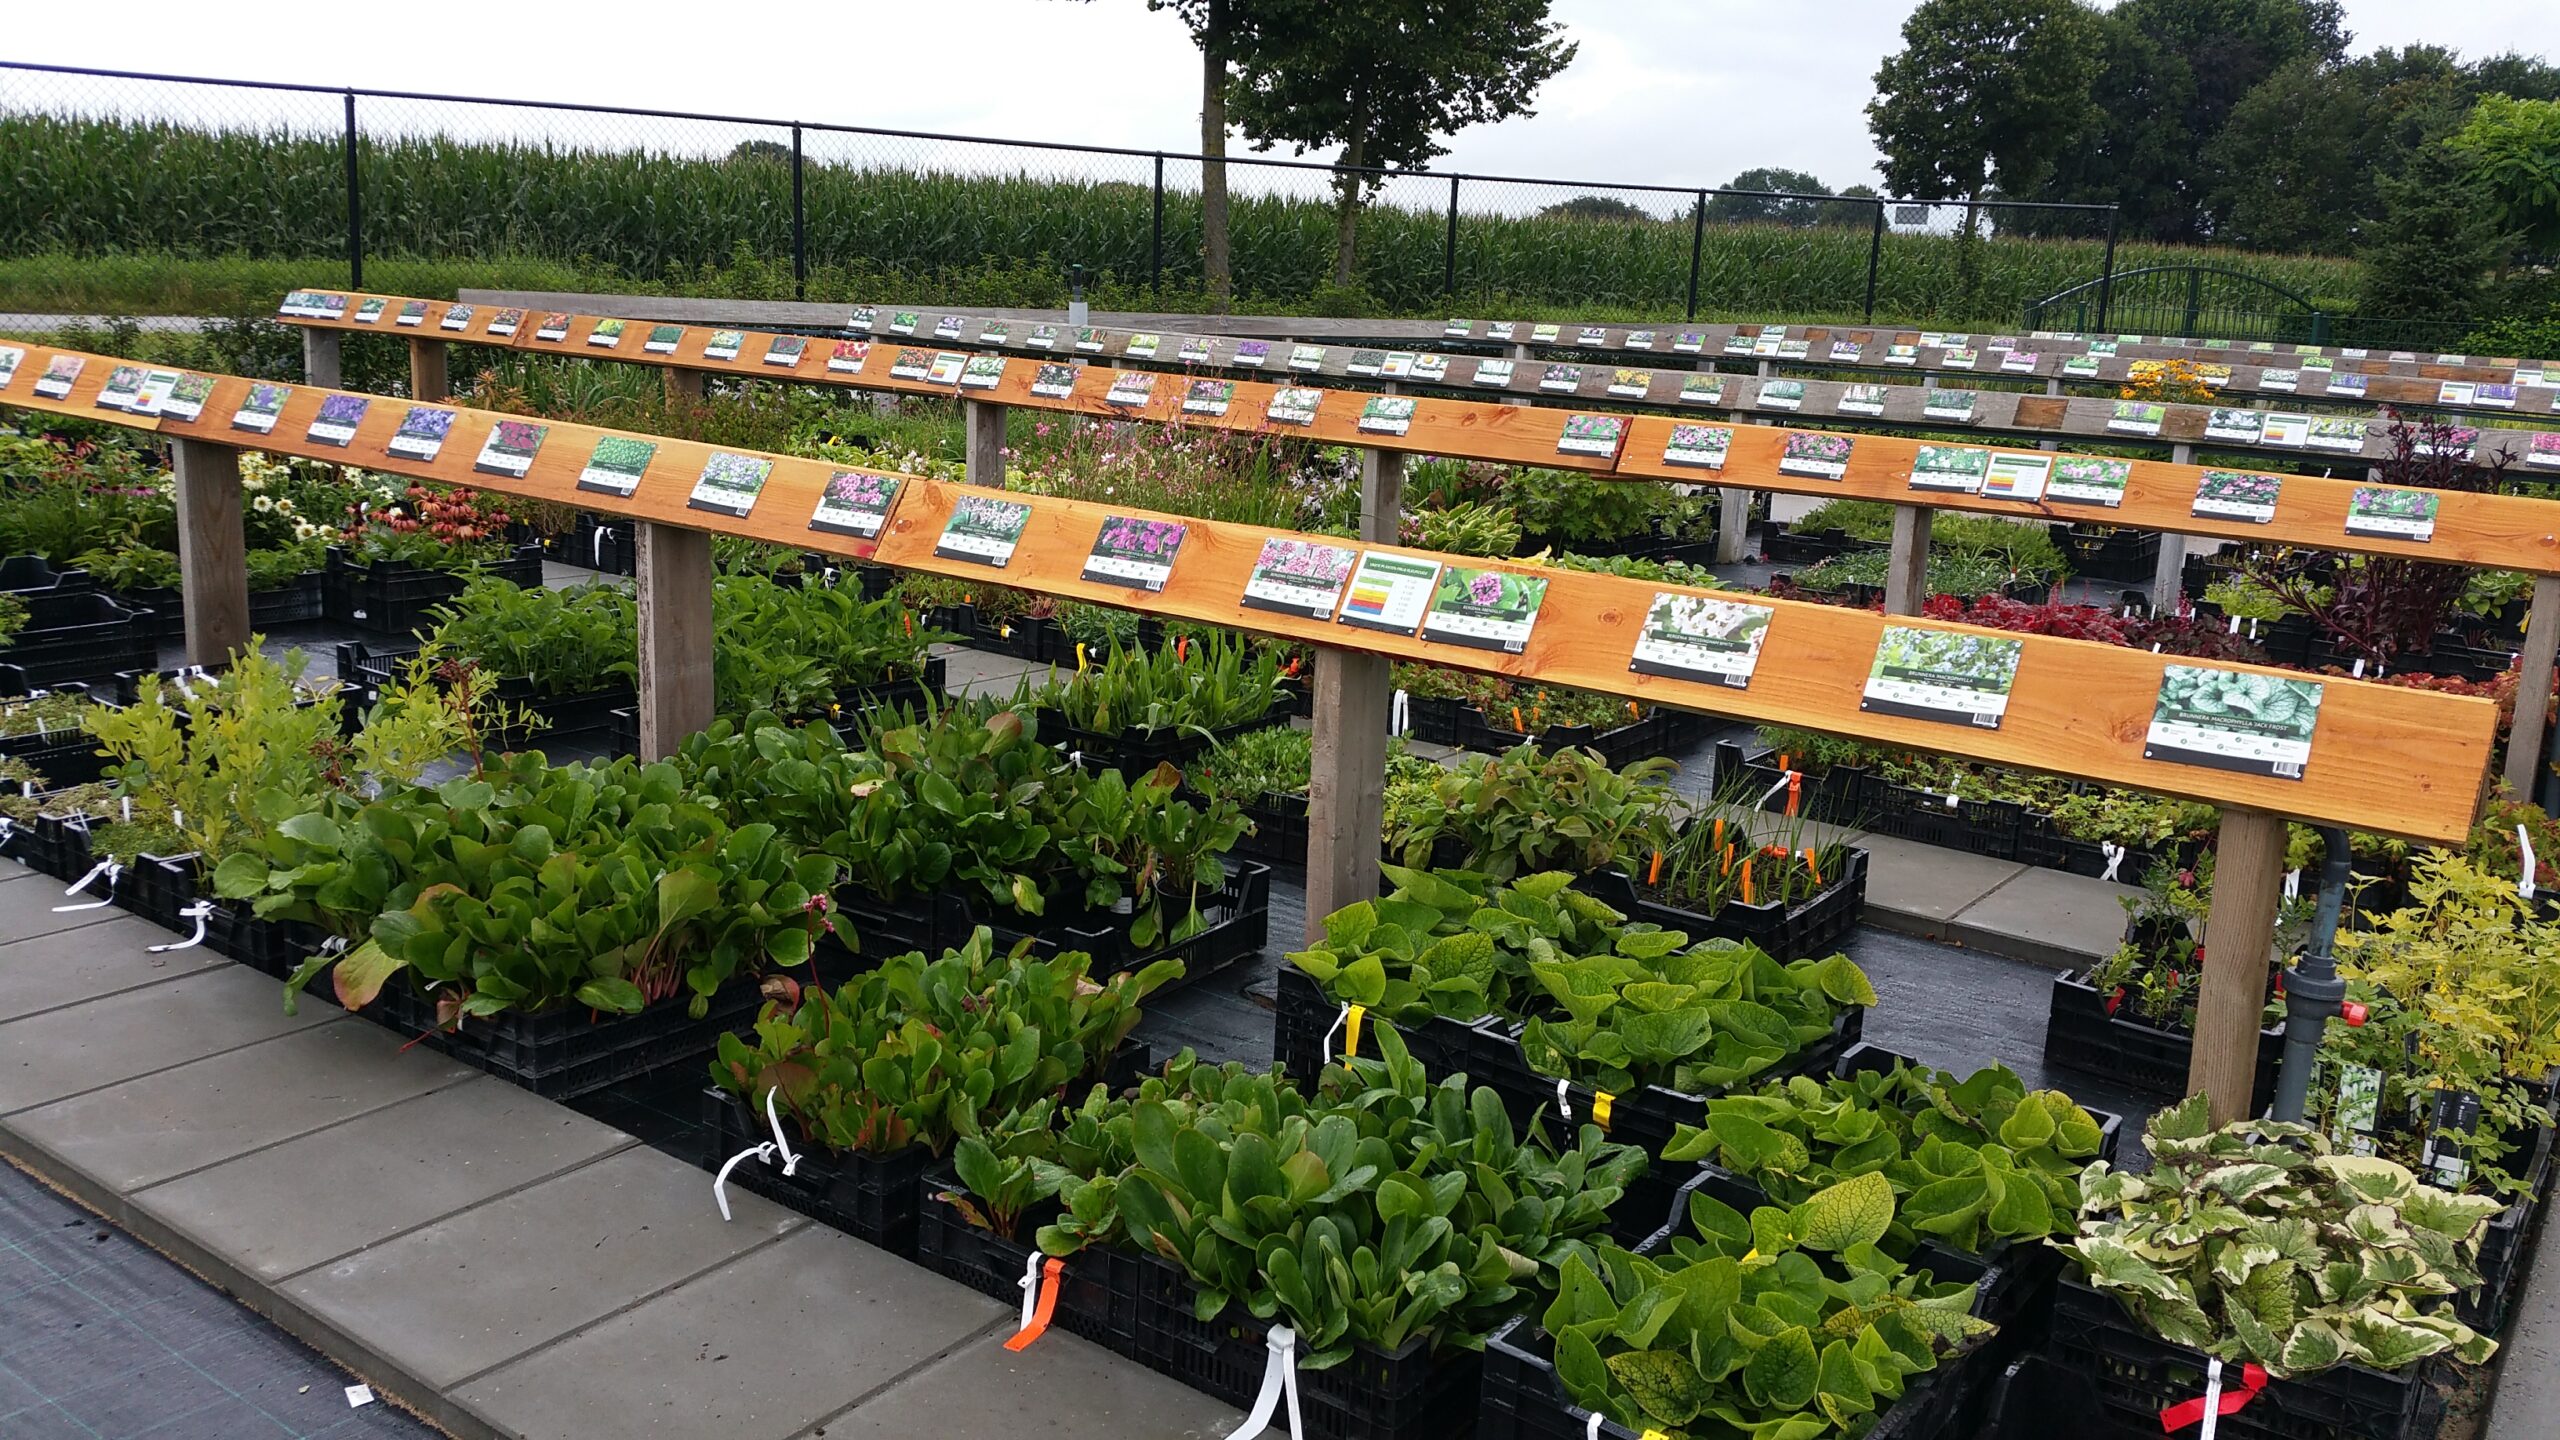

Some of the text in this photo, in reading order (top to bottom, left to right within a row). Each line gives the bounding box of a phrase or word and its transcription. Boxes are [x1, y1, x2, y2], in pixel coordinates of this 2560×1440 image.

[1908, 670, 1935, 679] BRUNNERA
[1936, 674, 1974, 683] MACROPHYLLA
[2179, 712, 2210, 721] BRUNNERA
[2211, 717, 2253, 727] MACROPHYLLA
